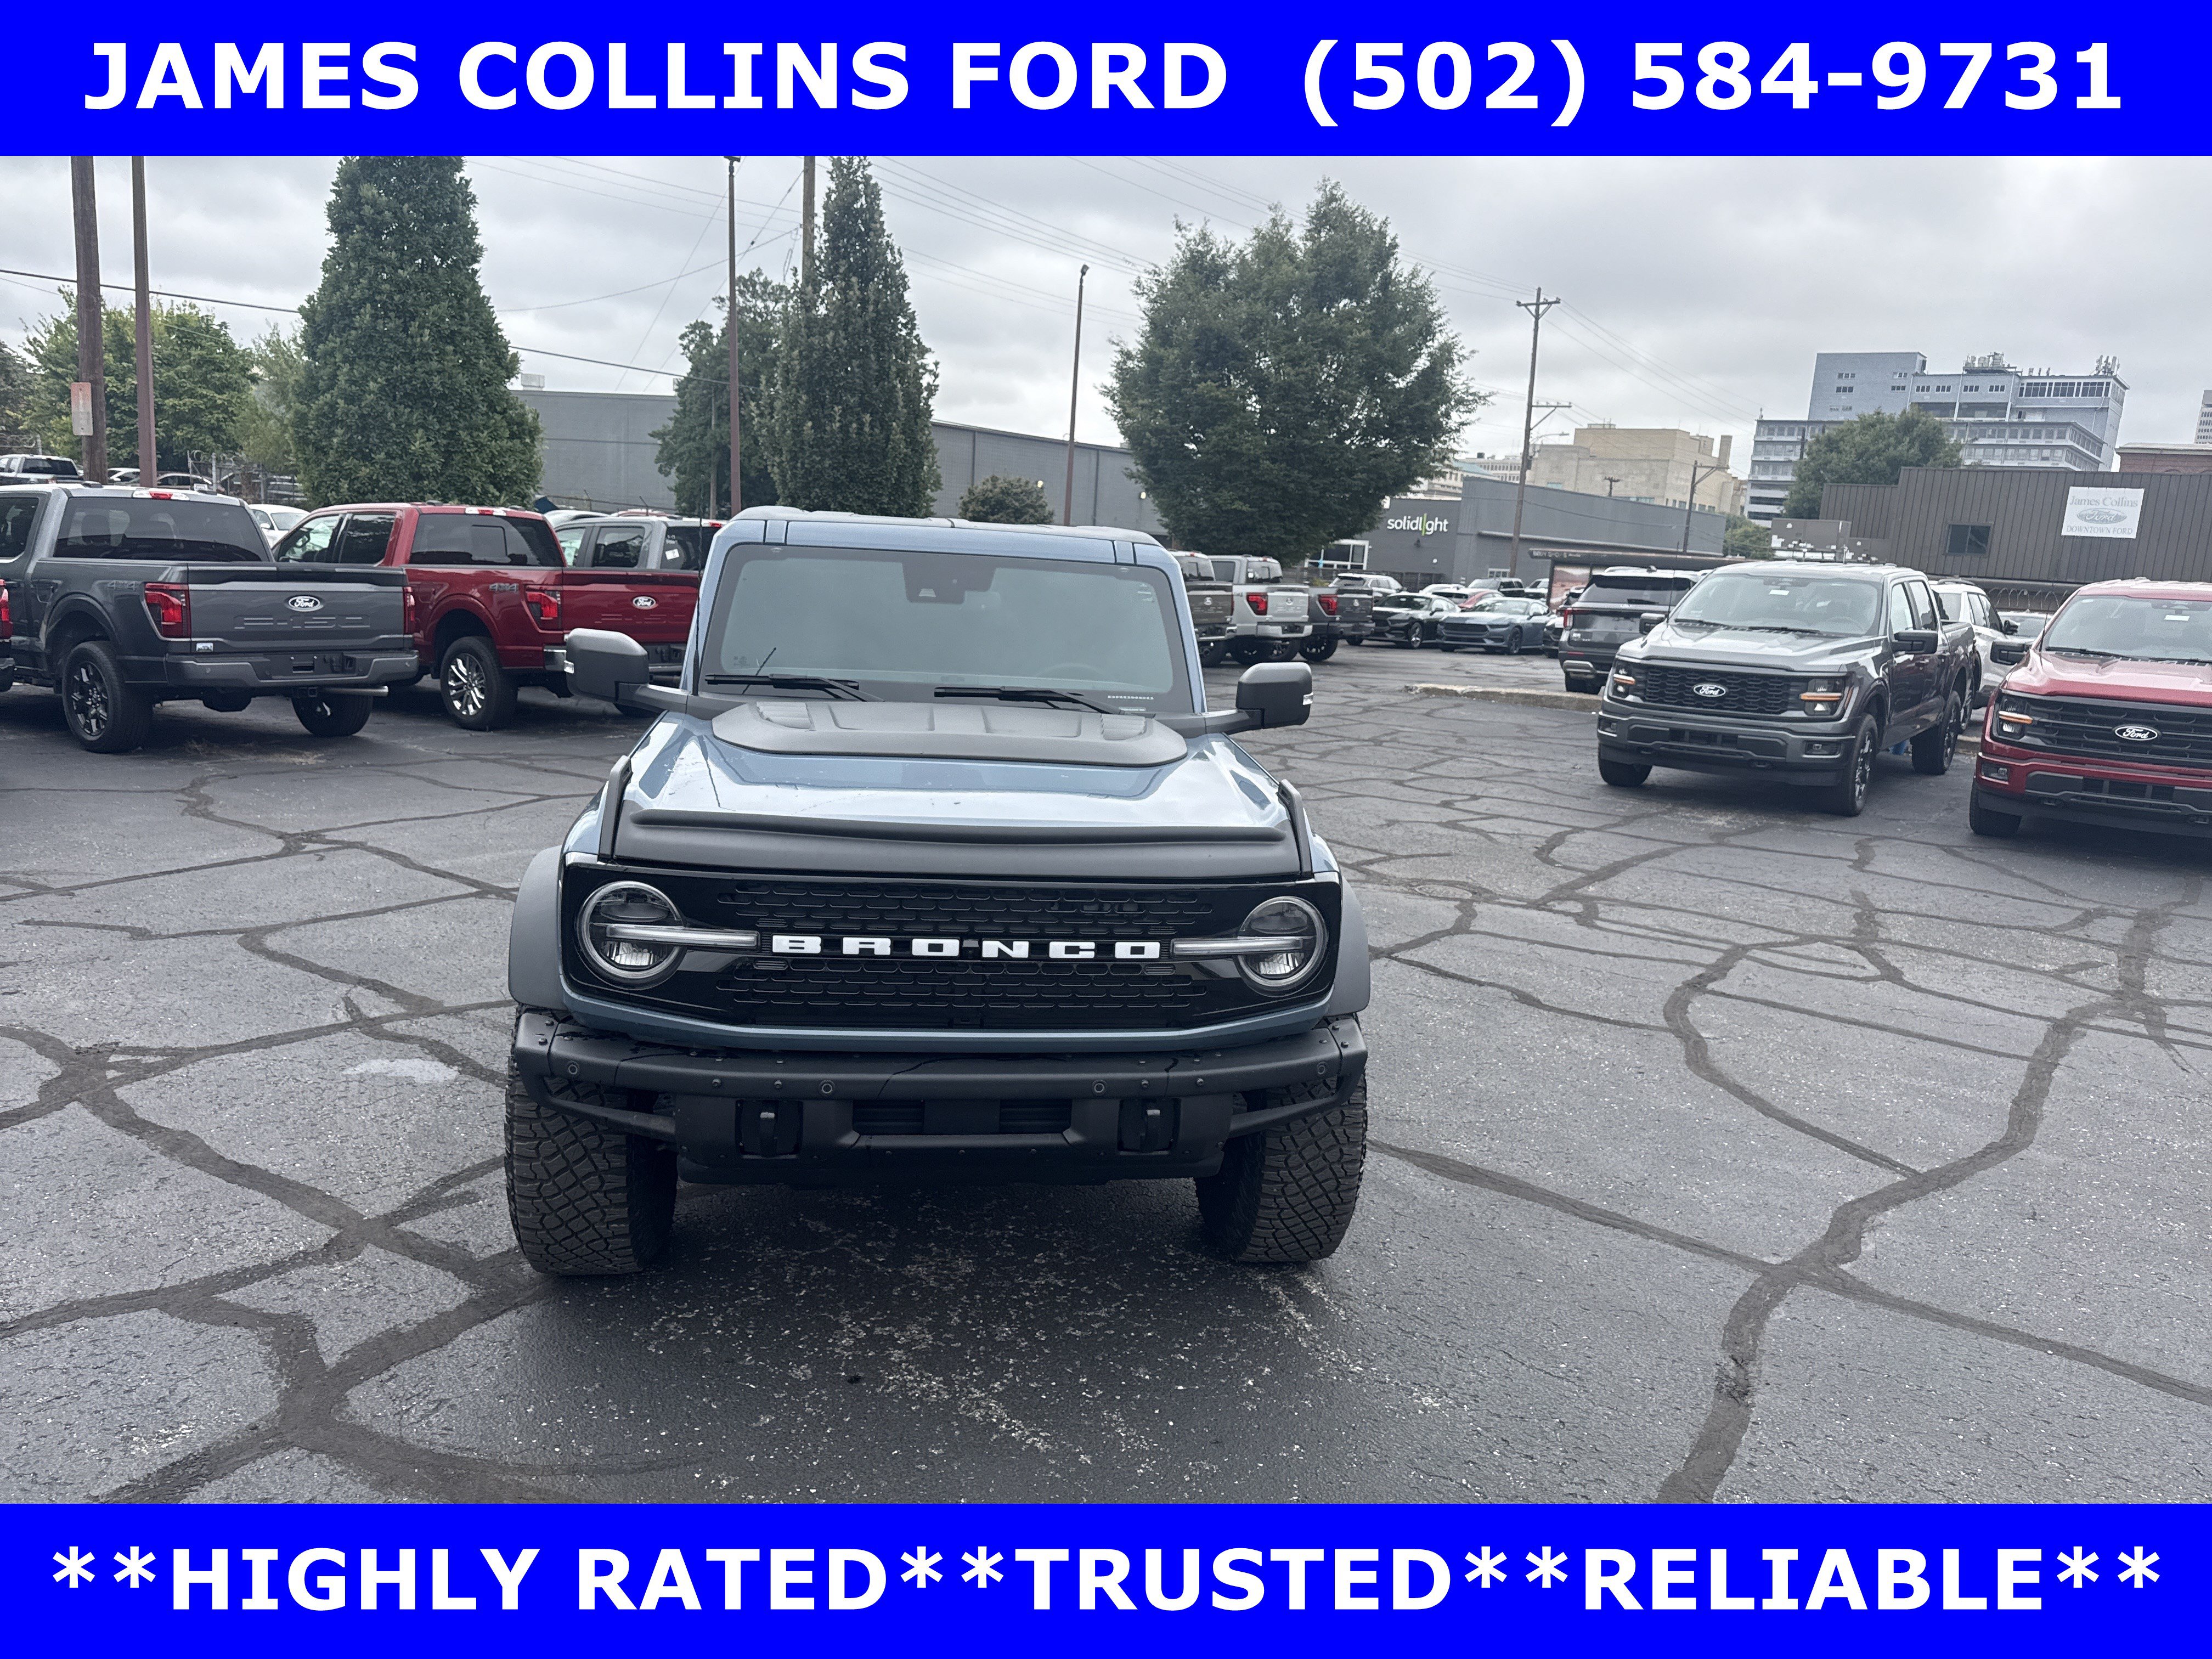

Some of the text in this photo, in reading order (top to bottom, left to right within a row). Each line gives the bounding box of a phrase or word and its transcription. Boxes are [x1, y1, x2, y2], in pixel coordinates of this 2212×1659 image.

[2069, 496, 2138, 507] James Collins
[2085, 510, 2119, 521] Ford
[2066, 525, 2134, 535] DOWNTOWN FORD
[772, 934, 1160, 959] BRONCO
